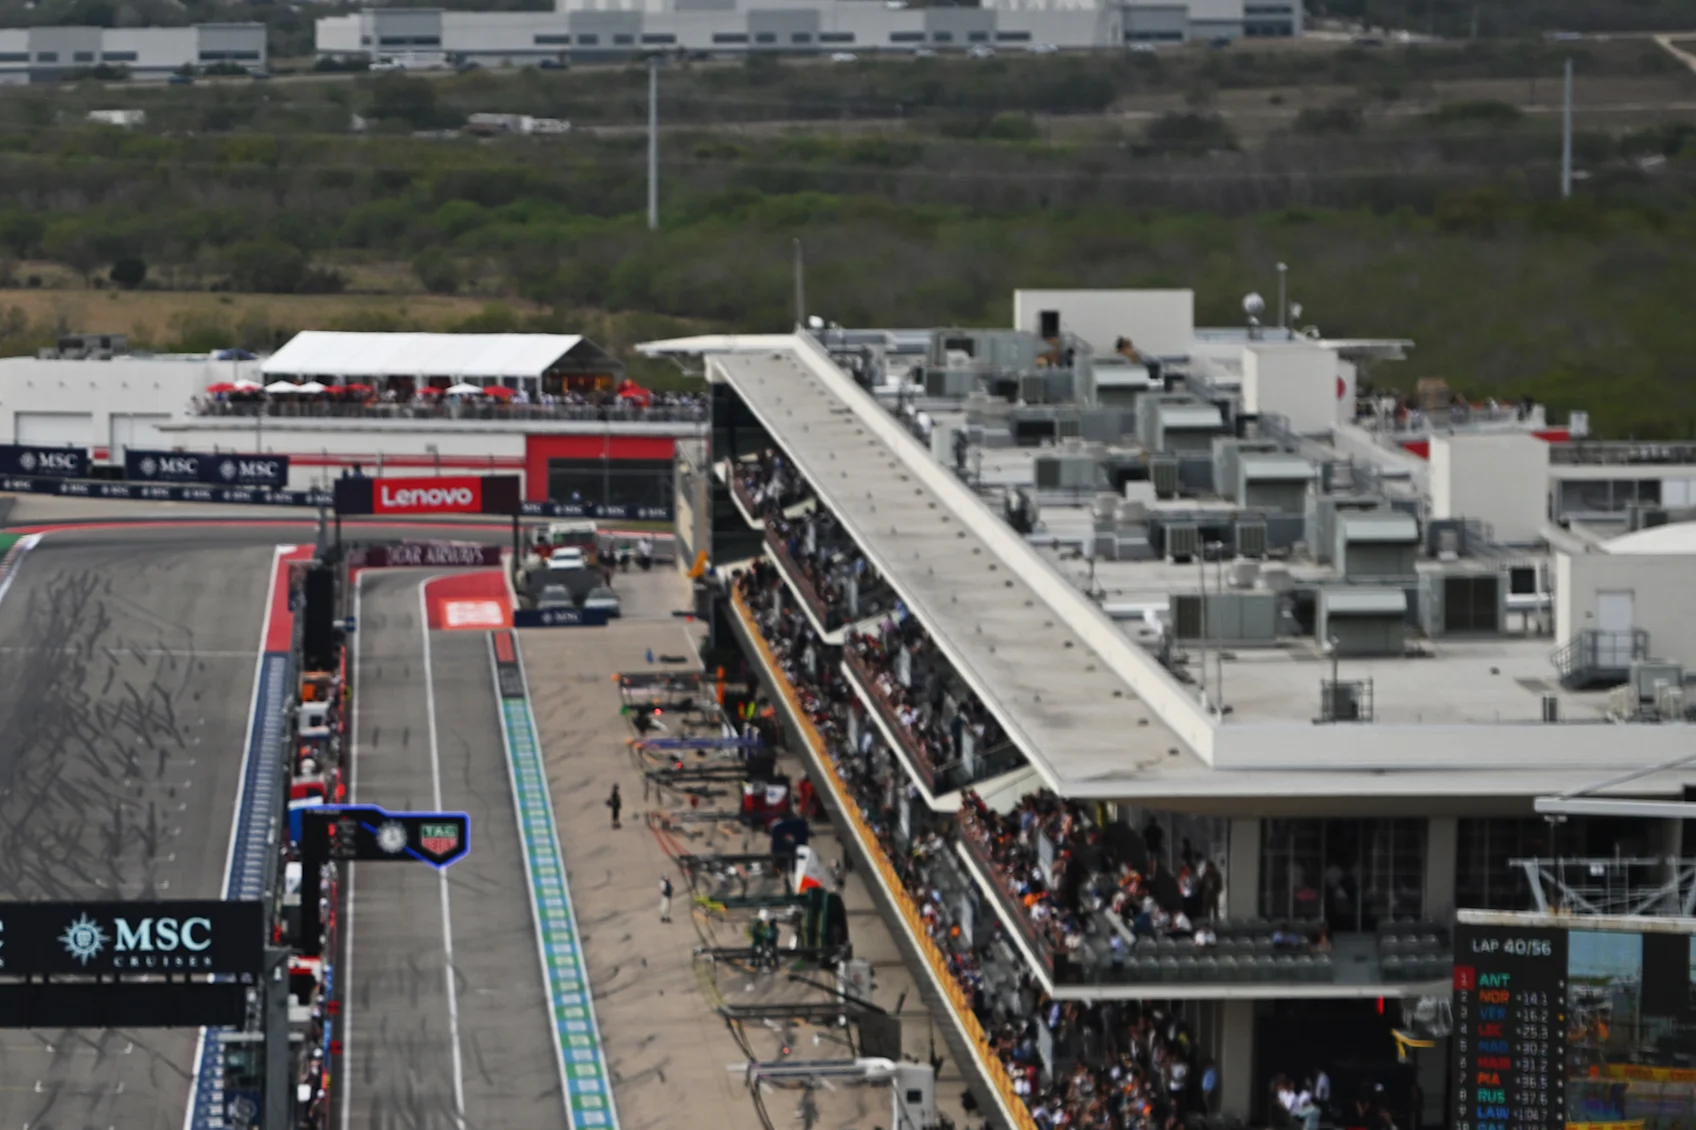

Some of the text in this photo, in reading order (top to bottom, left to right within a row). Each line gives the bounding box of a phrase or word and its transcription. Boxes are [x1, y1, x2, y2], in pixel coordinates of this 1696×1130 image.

[39, 453, 79, 469] MSC
[159, 457, 199, 474] MSC
[239, 460, 279, 477] MSC
[381, 486, 472, 507] Lenovo
[114, 917, 211, 951] MSC
[1472, 938, 1552, 956] LAP 40/56
[114, 955, 212, 967] CRUISES
[1479, 973, 1510, 987] ANT
[1479, 989, 1510, 1004] NOR
[1477, 1072, 1501, 1085] PIA
[1478, 1088, 1505, 1103] RUS
[1477, 1105, 1509, 1120] LAW
